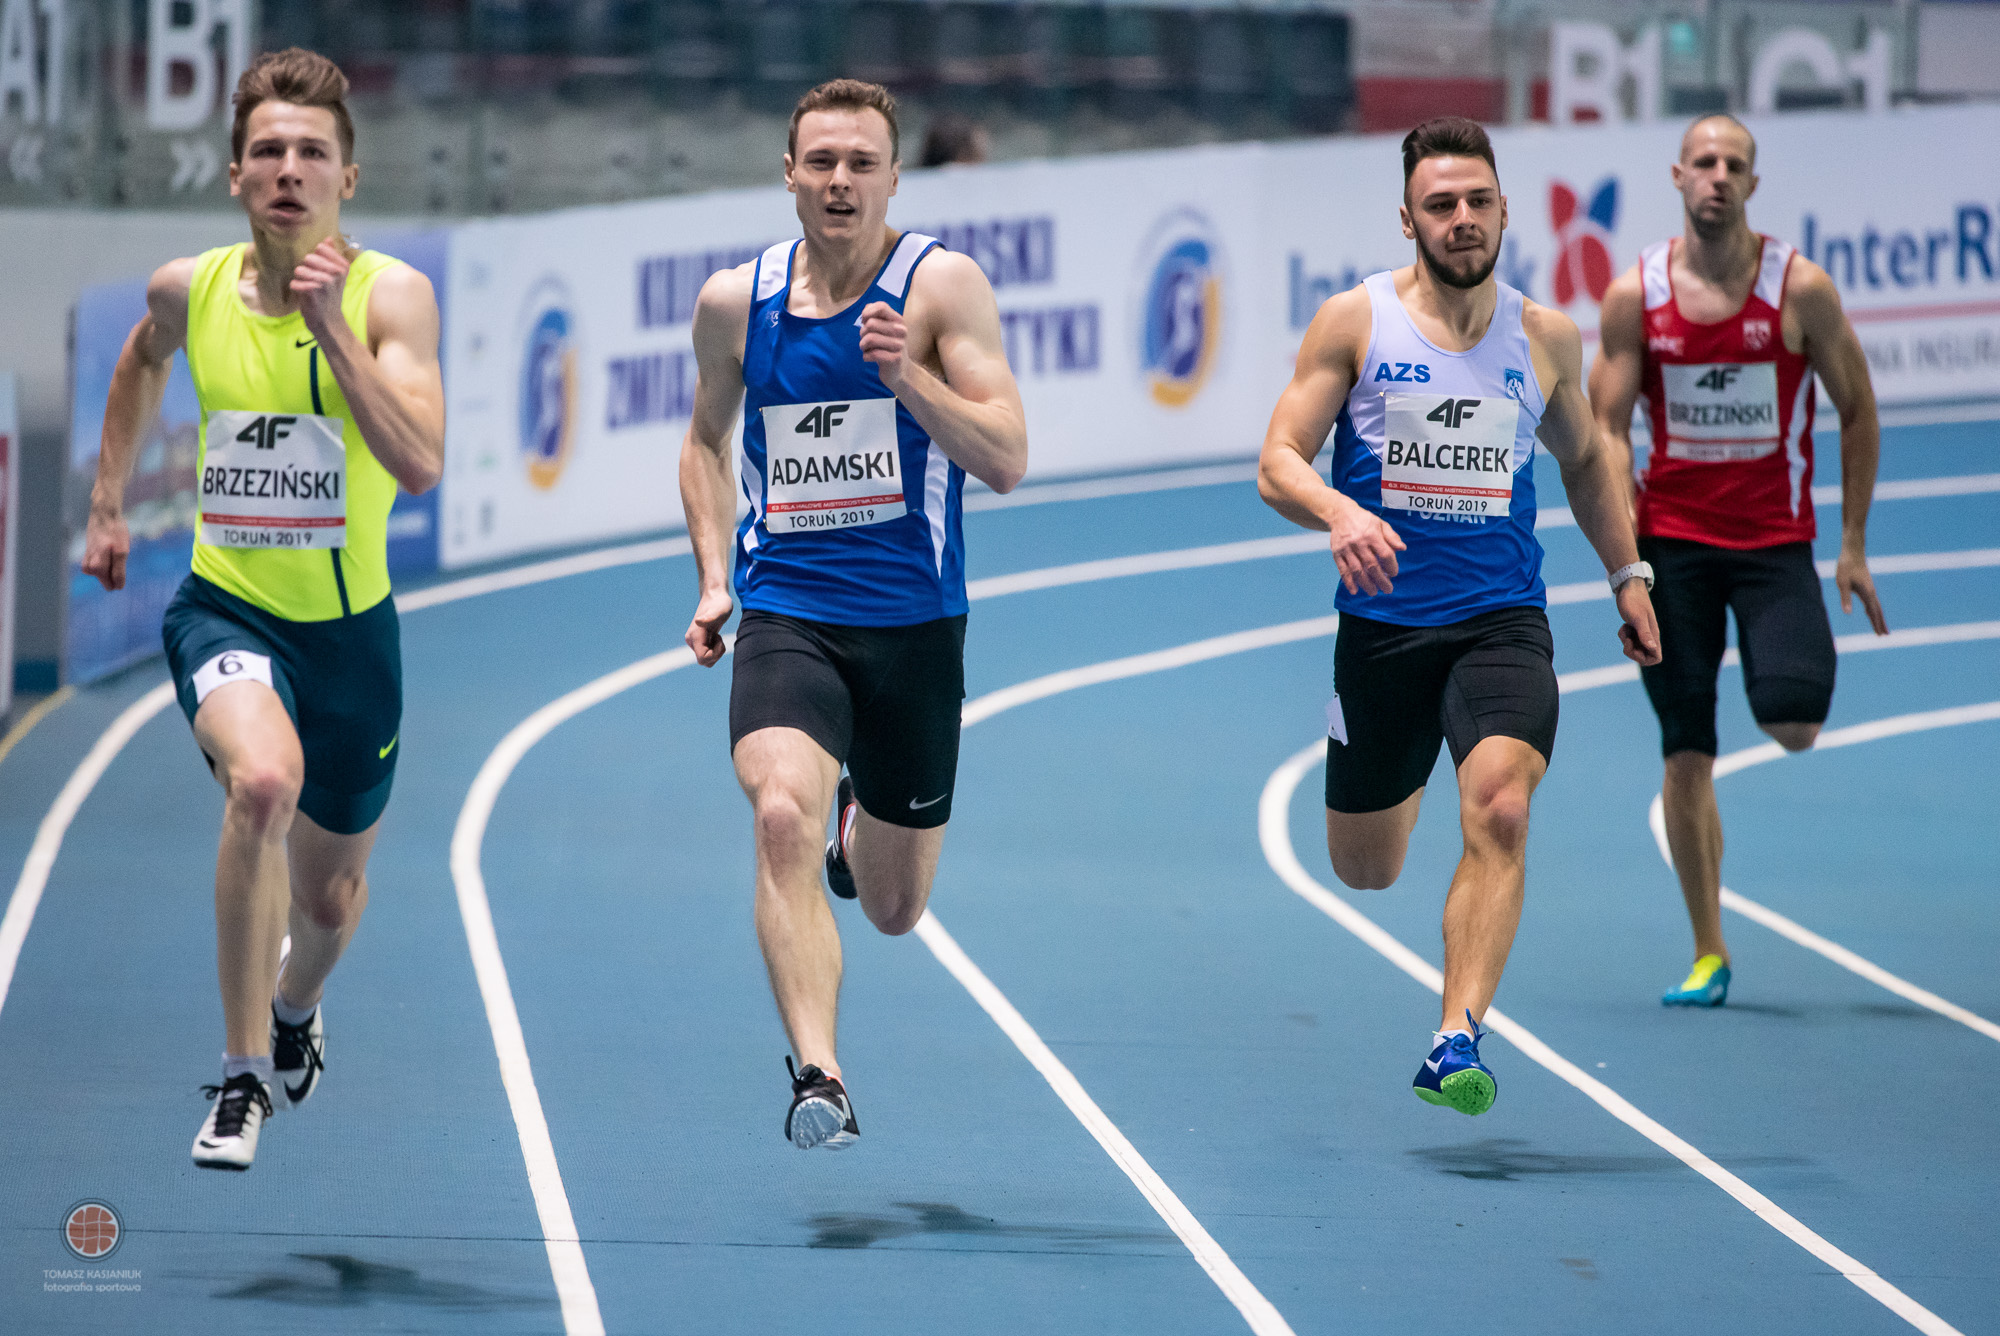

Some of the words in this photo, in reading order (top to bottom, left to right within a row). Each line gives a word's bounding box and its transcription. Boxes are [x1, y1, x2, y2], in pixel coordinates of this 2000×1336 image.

[1803, 205, 2000, 288] InterR
[1374, 362, 1431, 383] AZS
[1695, 363, 1741, 392] 4F
[795, 404, 850, 438] 4F
[1426, 398, 1481, 428] 4F
[236, 415, 297, 449] 4F
[771, 451, 895, 486] ADAMSKI
[1387, 440, 1509, 473] BALCEREK
[203, 463, 339, 499] BRZEZIŃSKI
[790, 510, 836, 528] TORUŃ
[840, 509, 875, 525] 2019
[1408, 495, 1454, 510] TORUŃ
[1457, 500, 1488, 513] 2019
[224, 527, 271, 544] TORUŃ
[276, 532, 312, 545] 2019
[218, 653, 243, 676] 6
